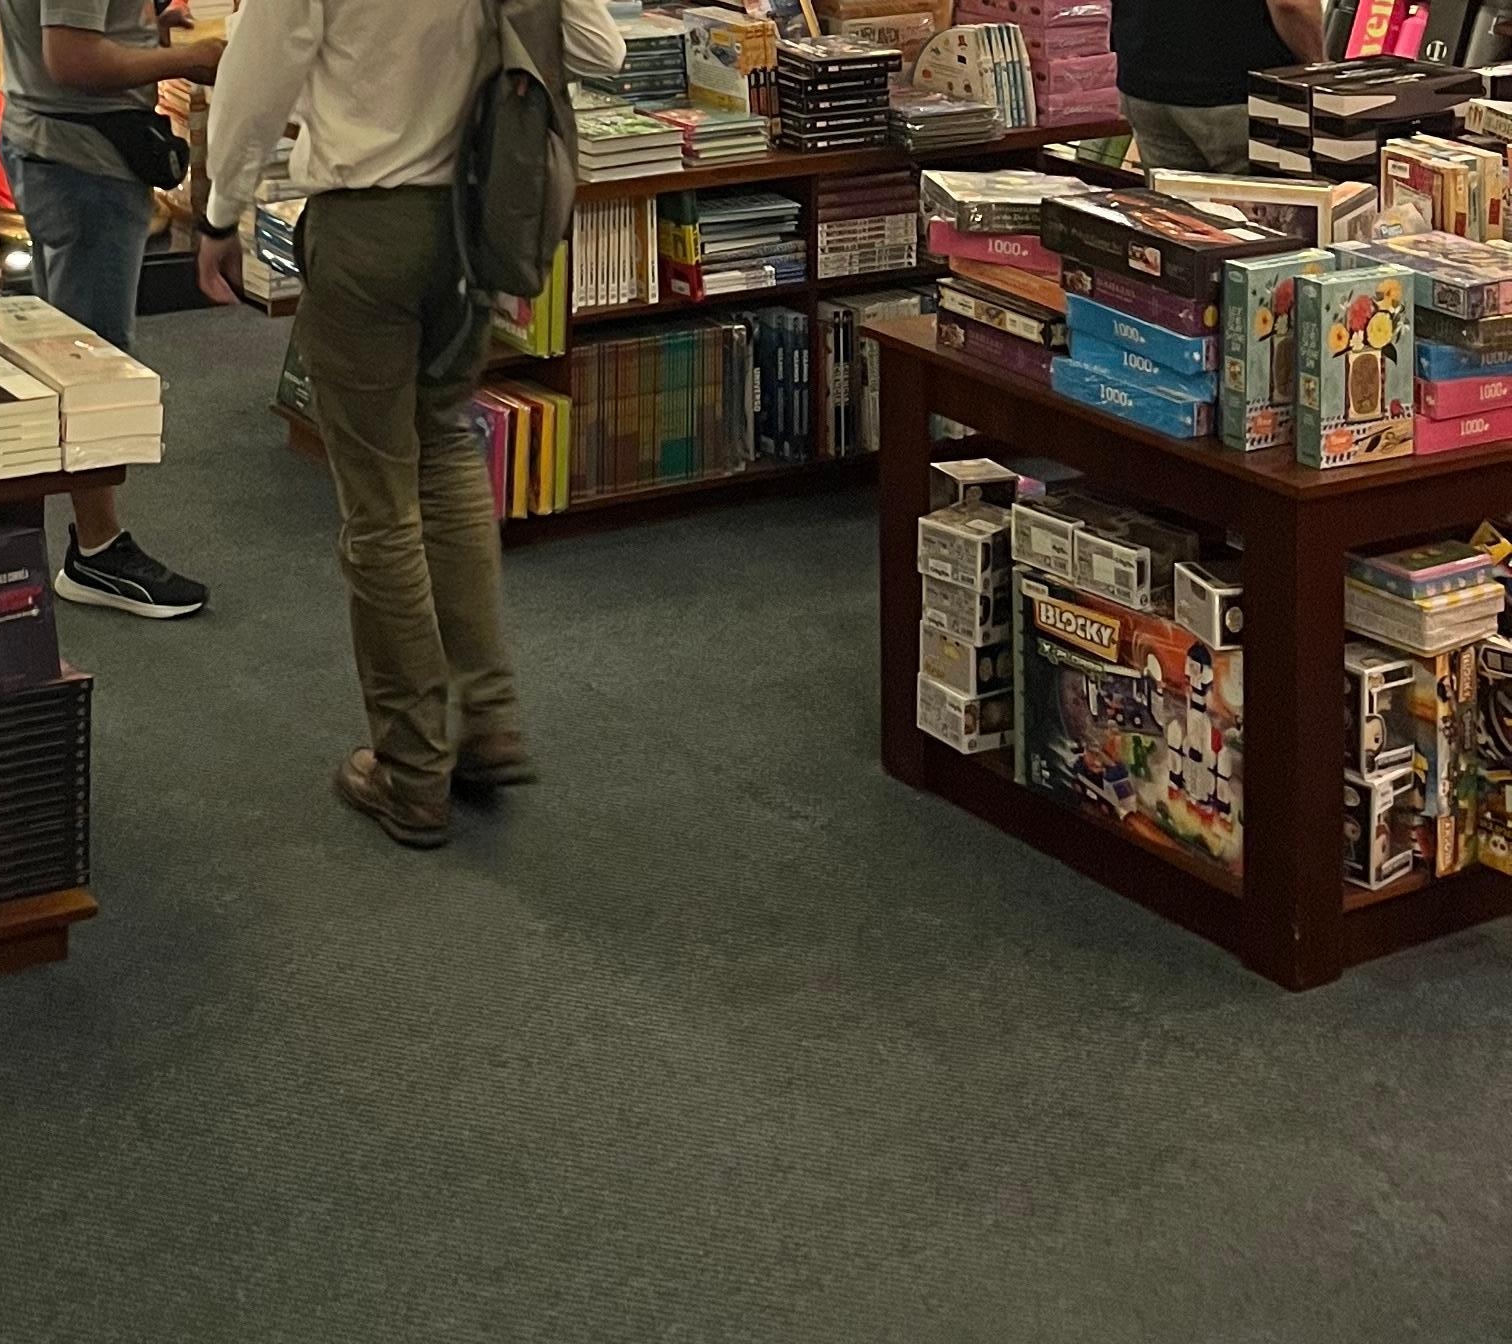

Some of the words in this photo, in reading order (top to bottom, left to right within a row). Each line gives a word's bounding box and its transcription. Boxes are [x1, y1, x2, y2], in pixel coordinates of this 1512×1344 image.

[988, 238, 1022, 257] 1000
[1113, 319, 1140, 340] 1000
[1122, 351, 1154, 374] 1000
[1099, 383, 1129, 407] 1000
[1479, 382, 1504, 400] 1000
[1460, 418, 1485, 437] 1000
[1039, 601, 1113, 648] BLOCKY
